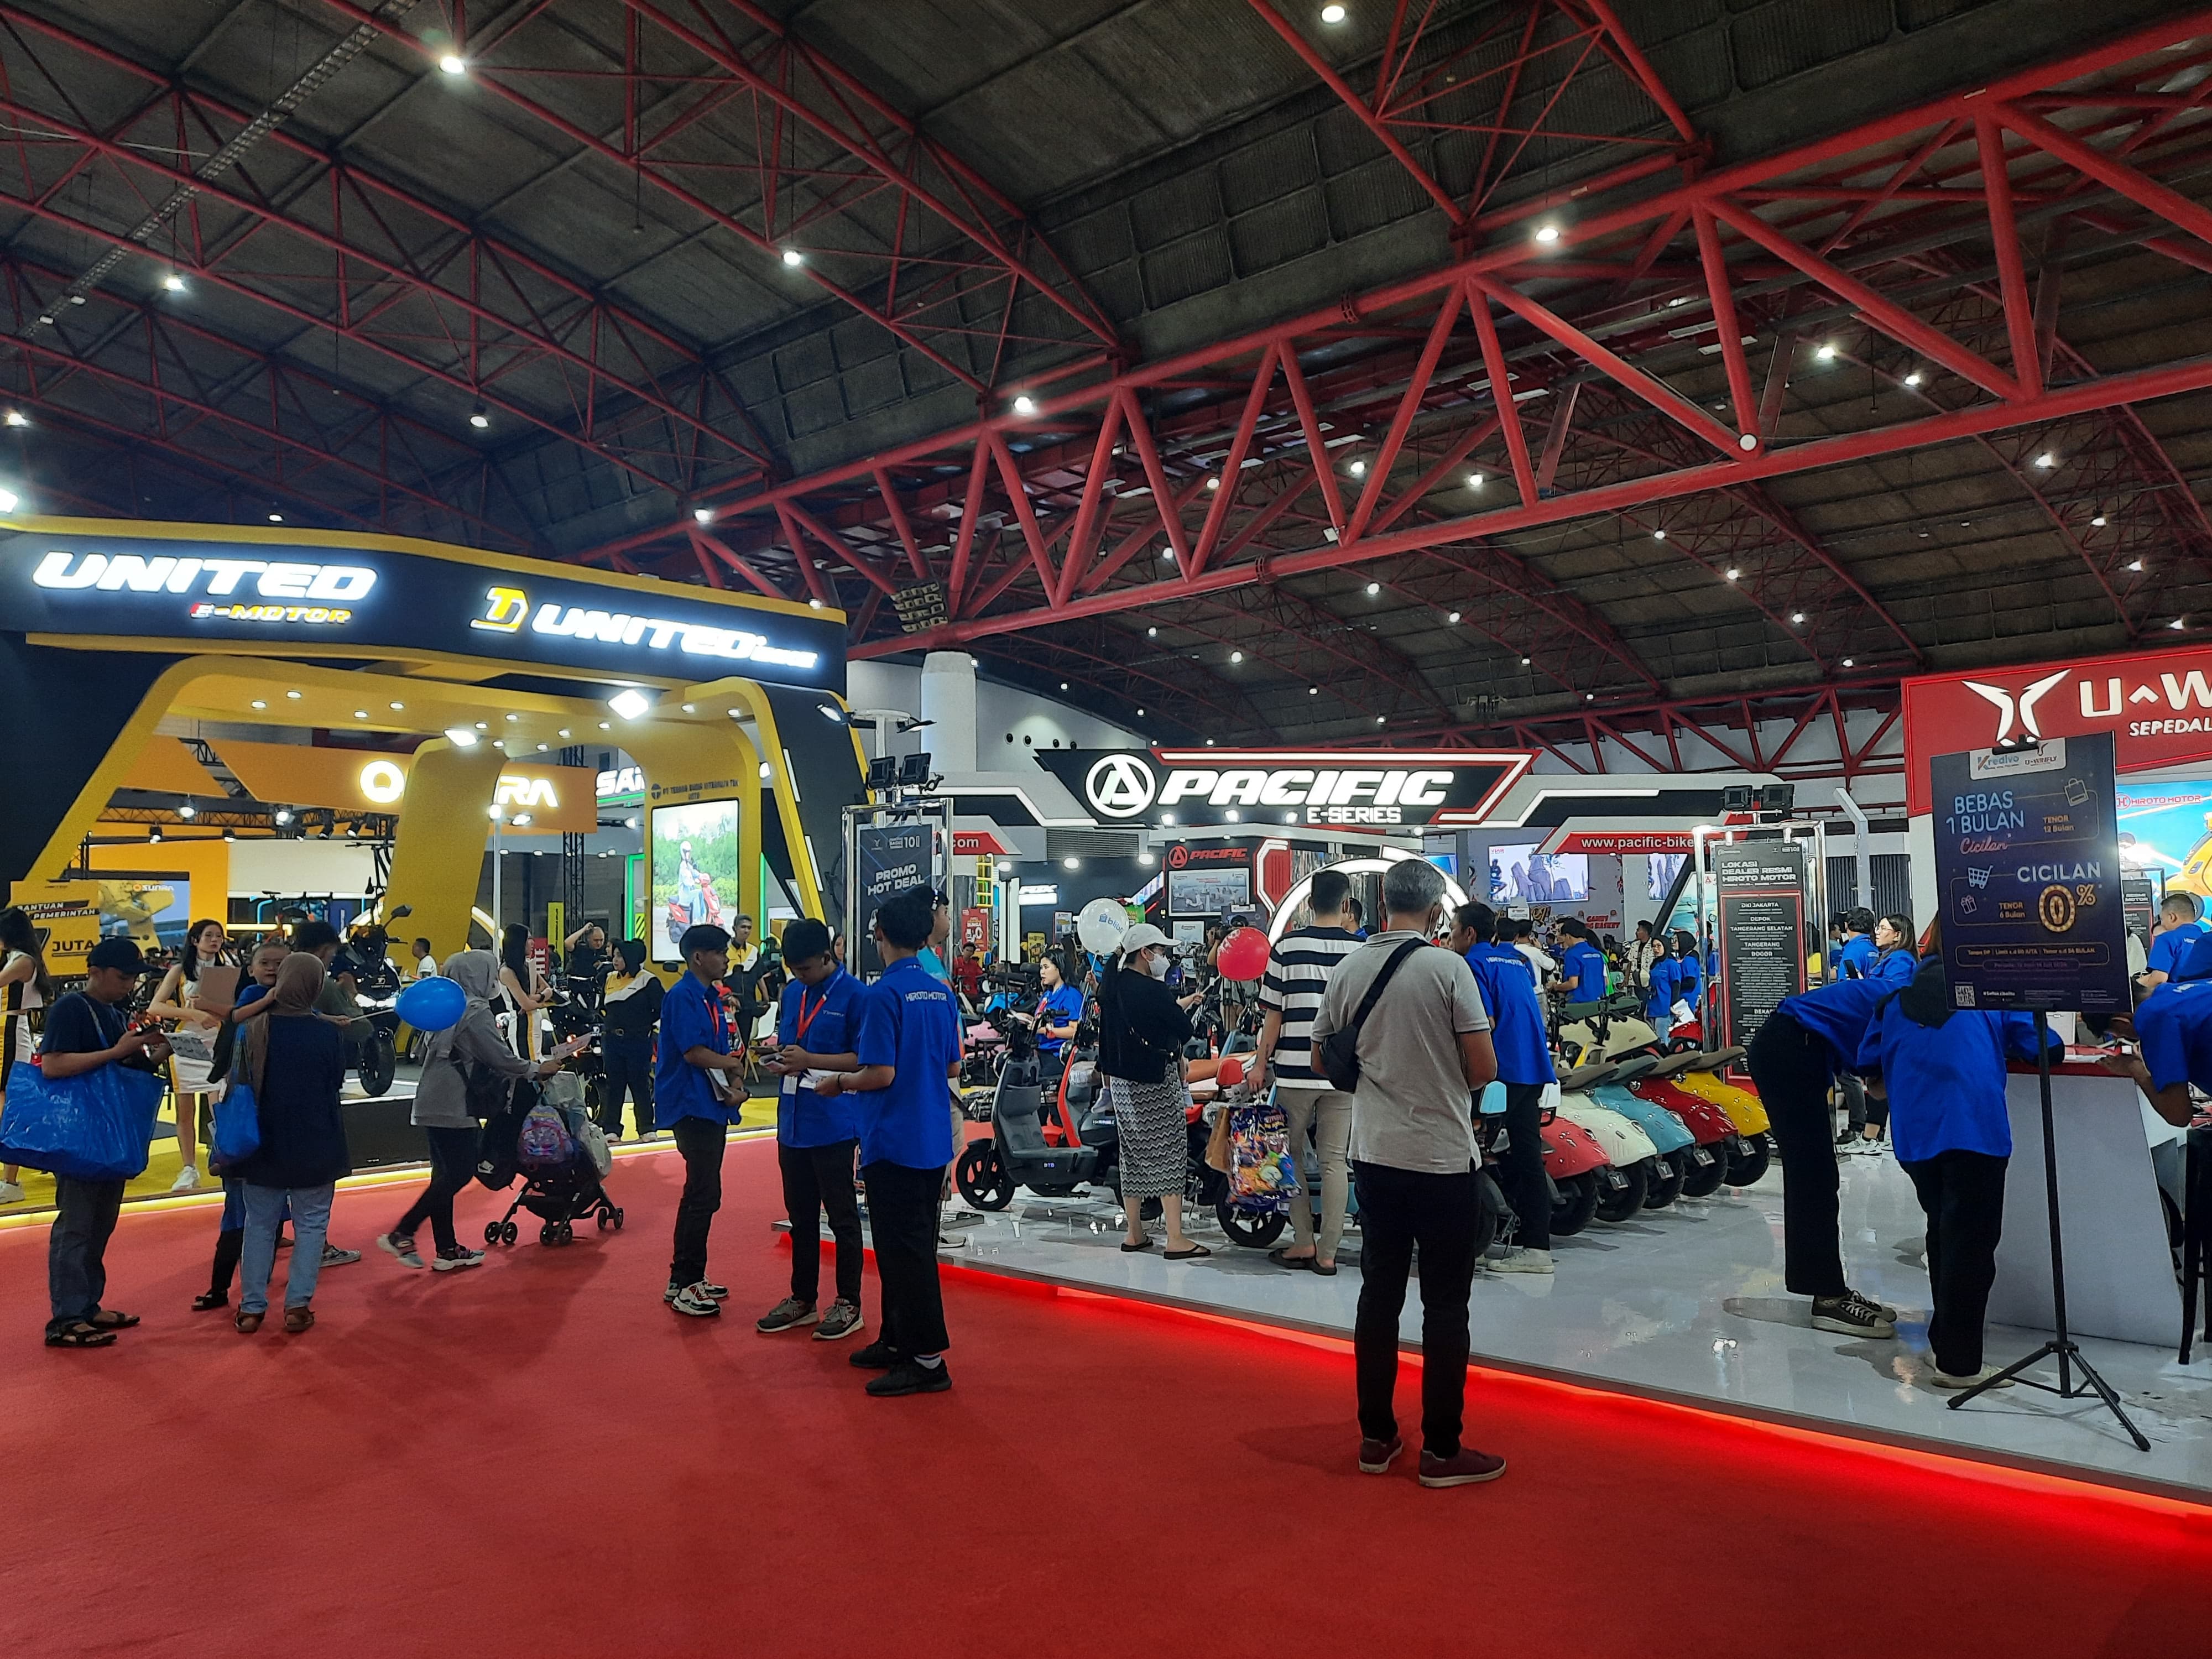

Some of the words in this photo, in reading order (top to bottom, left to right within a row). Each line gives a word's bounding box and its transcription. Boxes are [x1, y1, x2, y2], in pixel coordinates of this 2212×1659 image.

[32, 551, 379, 601] UNITED
[190, 603, 353, 624] E-MOTOR
[531, 603, 759, 659] UNITED
[1978, 754, 2020, 771] Kredivo
[1157, 770, 1454, 806] PACIFIC
[1954, 791, 2013, 815] BEBAS
[2131, 797, 2166, 805] HIROTO
[1306, 806, 1402, 824] E-SERIES
[1946, 817, 1955, 834] 1
[1961, 810, 2025, 834] BULAN
[2053, 824, 2074, 833] Bulan
[1190, 848, 1248, 859] PACIFIC
[1960, 836, 2008, 854] Cicilan
[875, 864, 917, 883] PROMO
[1760, 873, 1797, 881] MOTOR
[2017, 862, 2101, 883] CICILAN
[868, 881, 892, 896] HOT
[894, 874, 925, 890] DEAL
[17, 901, 64, 911] BANTUAN
[34, 909, 96, 920] PEMERINTAH
[52, 940, 94, 952] JUTA
[928, 992, 947, 1001] MOTOR
